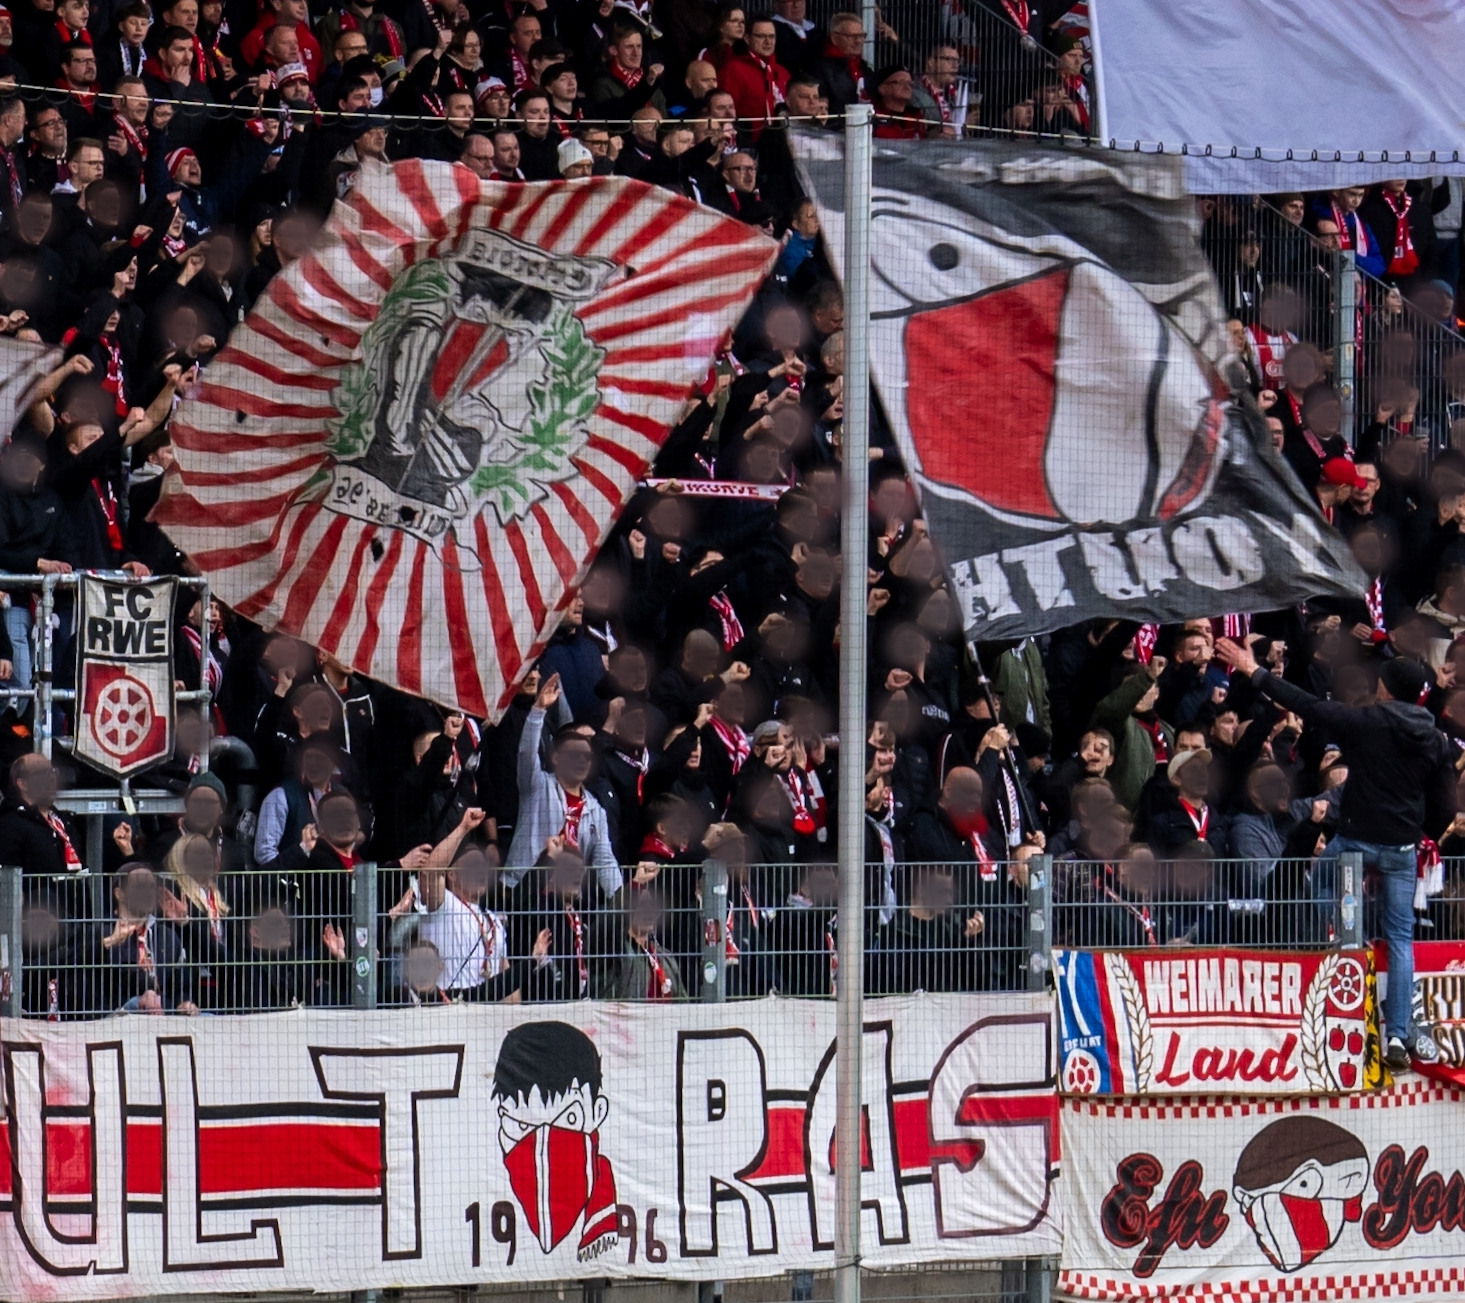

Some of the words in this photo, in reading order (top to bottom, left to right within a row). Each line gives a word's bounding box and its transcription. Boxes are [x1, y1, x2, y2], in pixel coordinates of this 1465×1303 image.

[105, 585, 157, 618] FC
[88, 618, 167, 655] RWE
[1144, 954, 1303, 1014] WEIMARER
[1155, 1031, 1300, 1085] Land
[1101, 1151, 1230, 1278] Efu
